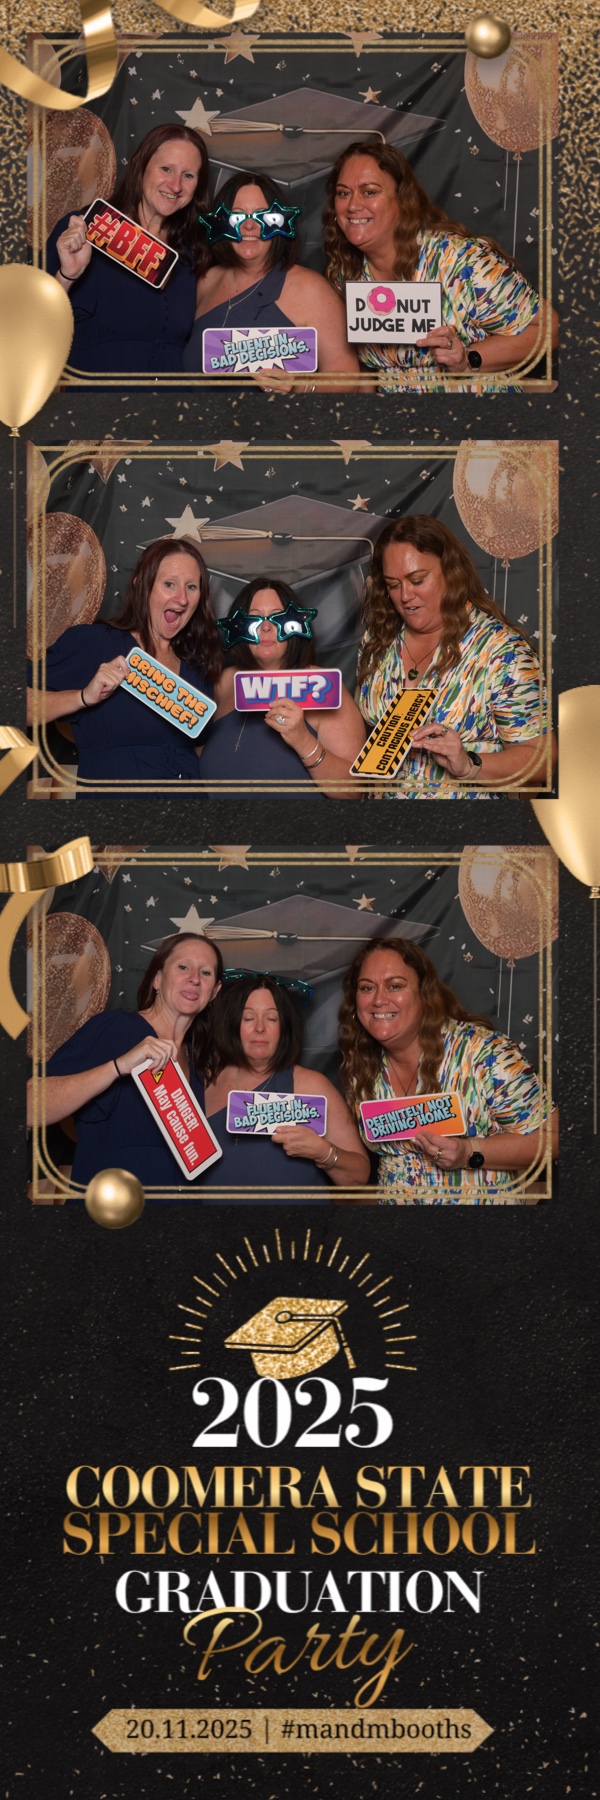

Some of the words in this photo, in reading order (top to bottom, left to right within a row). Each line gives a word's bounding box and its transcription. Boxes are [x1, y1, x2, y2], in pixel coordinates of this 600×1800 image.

[86, 211, 167, 279] #BFF
[349, 318, 405, 332] JUDGE
[411, 319, 436, 333] ME
[210, 354, 237, 370] BAD
[238, 340, 310, 364] DECISIONS.
[224, 337, 273, 356] FLUENT
[273, 332, 290, 346] IN
[129, 653, 177, 693] BRING
[176, 686, 209, 717] THE
[240, 674, 333, 703] WTF?
[375, 721, 410, 772] CONTAGIOUS
[170, 1087, 200, 1132] DANGER!
[234, 1114, 258, 1128] BAD
[260, 1107, 321, 1125] DECISIONS.
[246, 1101, 288, 1117] FLUENT
[289, 1099, 303, 1111] IN
[365, 1103, 426, 1130] DEFINITELY
[427, 1095, 453, 1114] NOT
[371, 1117, 418, 1139] DRIVING
[418, 1107, 456, 1127] HOME.
[152, 1083, 173, 1112] May
[165, 1109, 190, 1145] cause
[182, 1141, 196, 1167] fun.
